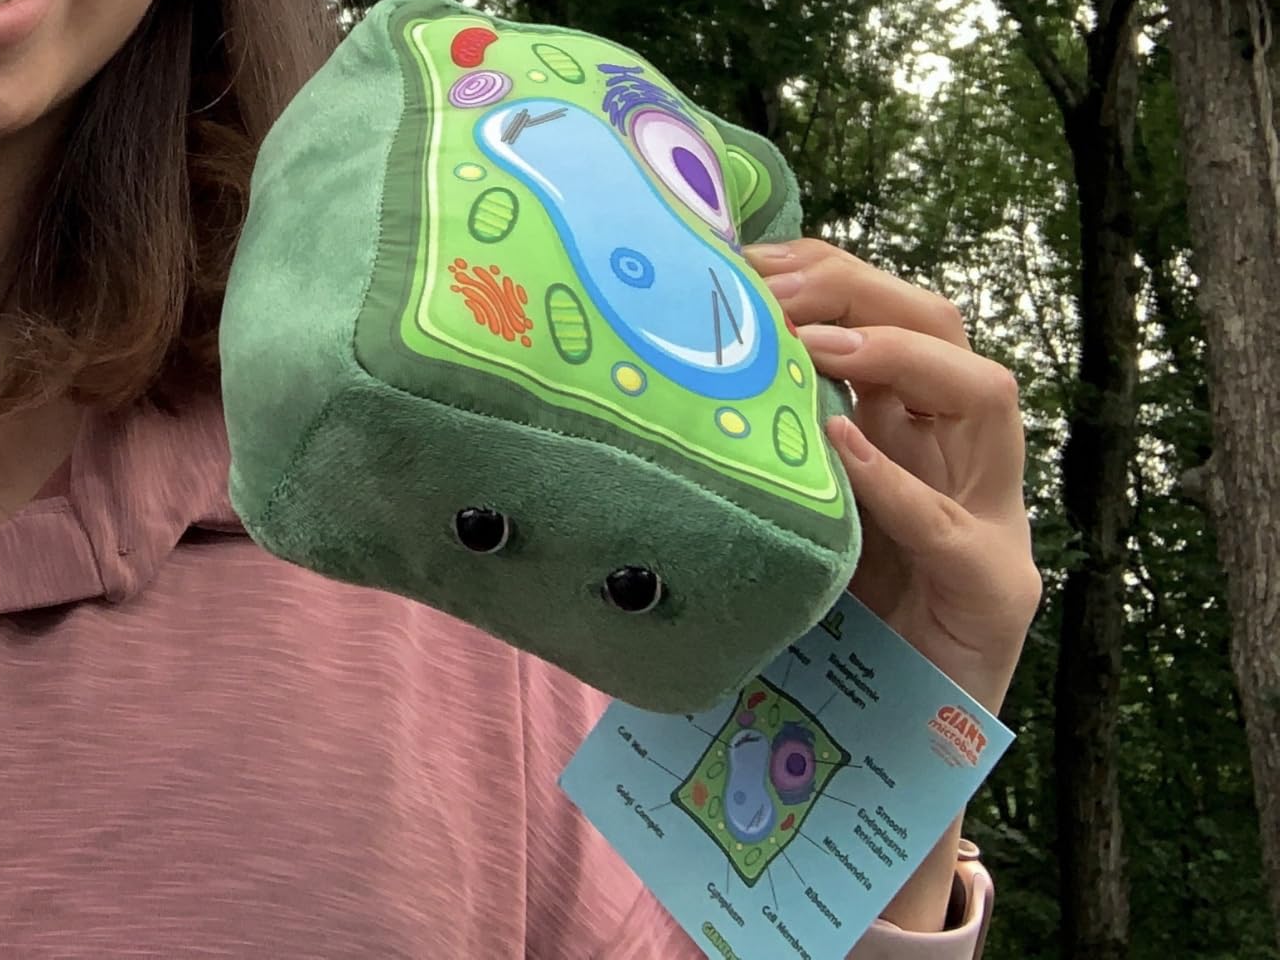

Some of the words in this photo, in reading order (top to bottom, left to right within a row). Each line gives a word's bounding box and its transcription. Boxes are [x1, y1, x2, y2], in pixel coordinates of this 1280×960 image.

[937, 706, 987, 754] GIANT
[864, 755, 896, 789] Nucleus
[634, 804, 665, 839] Complex
[857, 807, 908, 861] Endoplasmic
[875, 805, 908, 840] Smooth
[822, 836, 873, 892] Mitochondria
[853, 824, 894, 868] Reticulum
[706, 882, 746, 928] Cytoplasm
[761, 905, 778, 924] Cell
[803, 886, 843, 930] Ribosome
